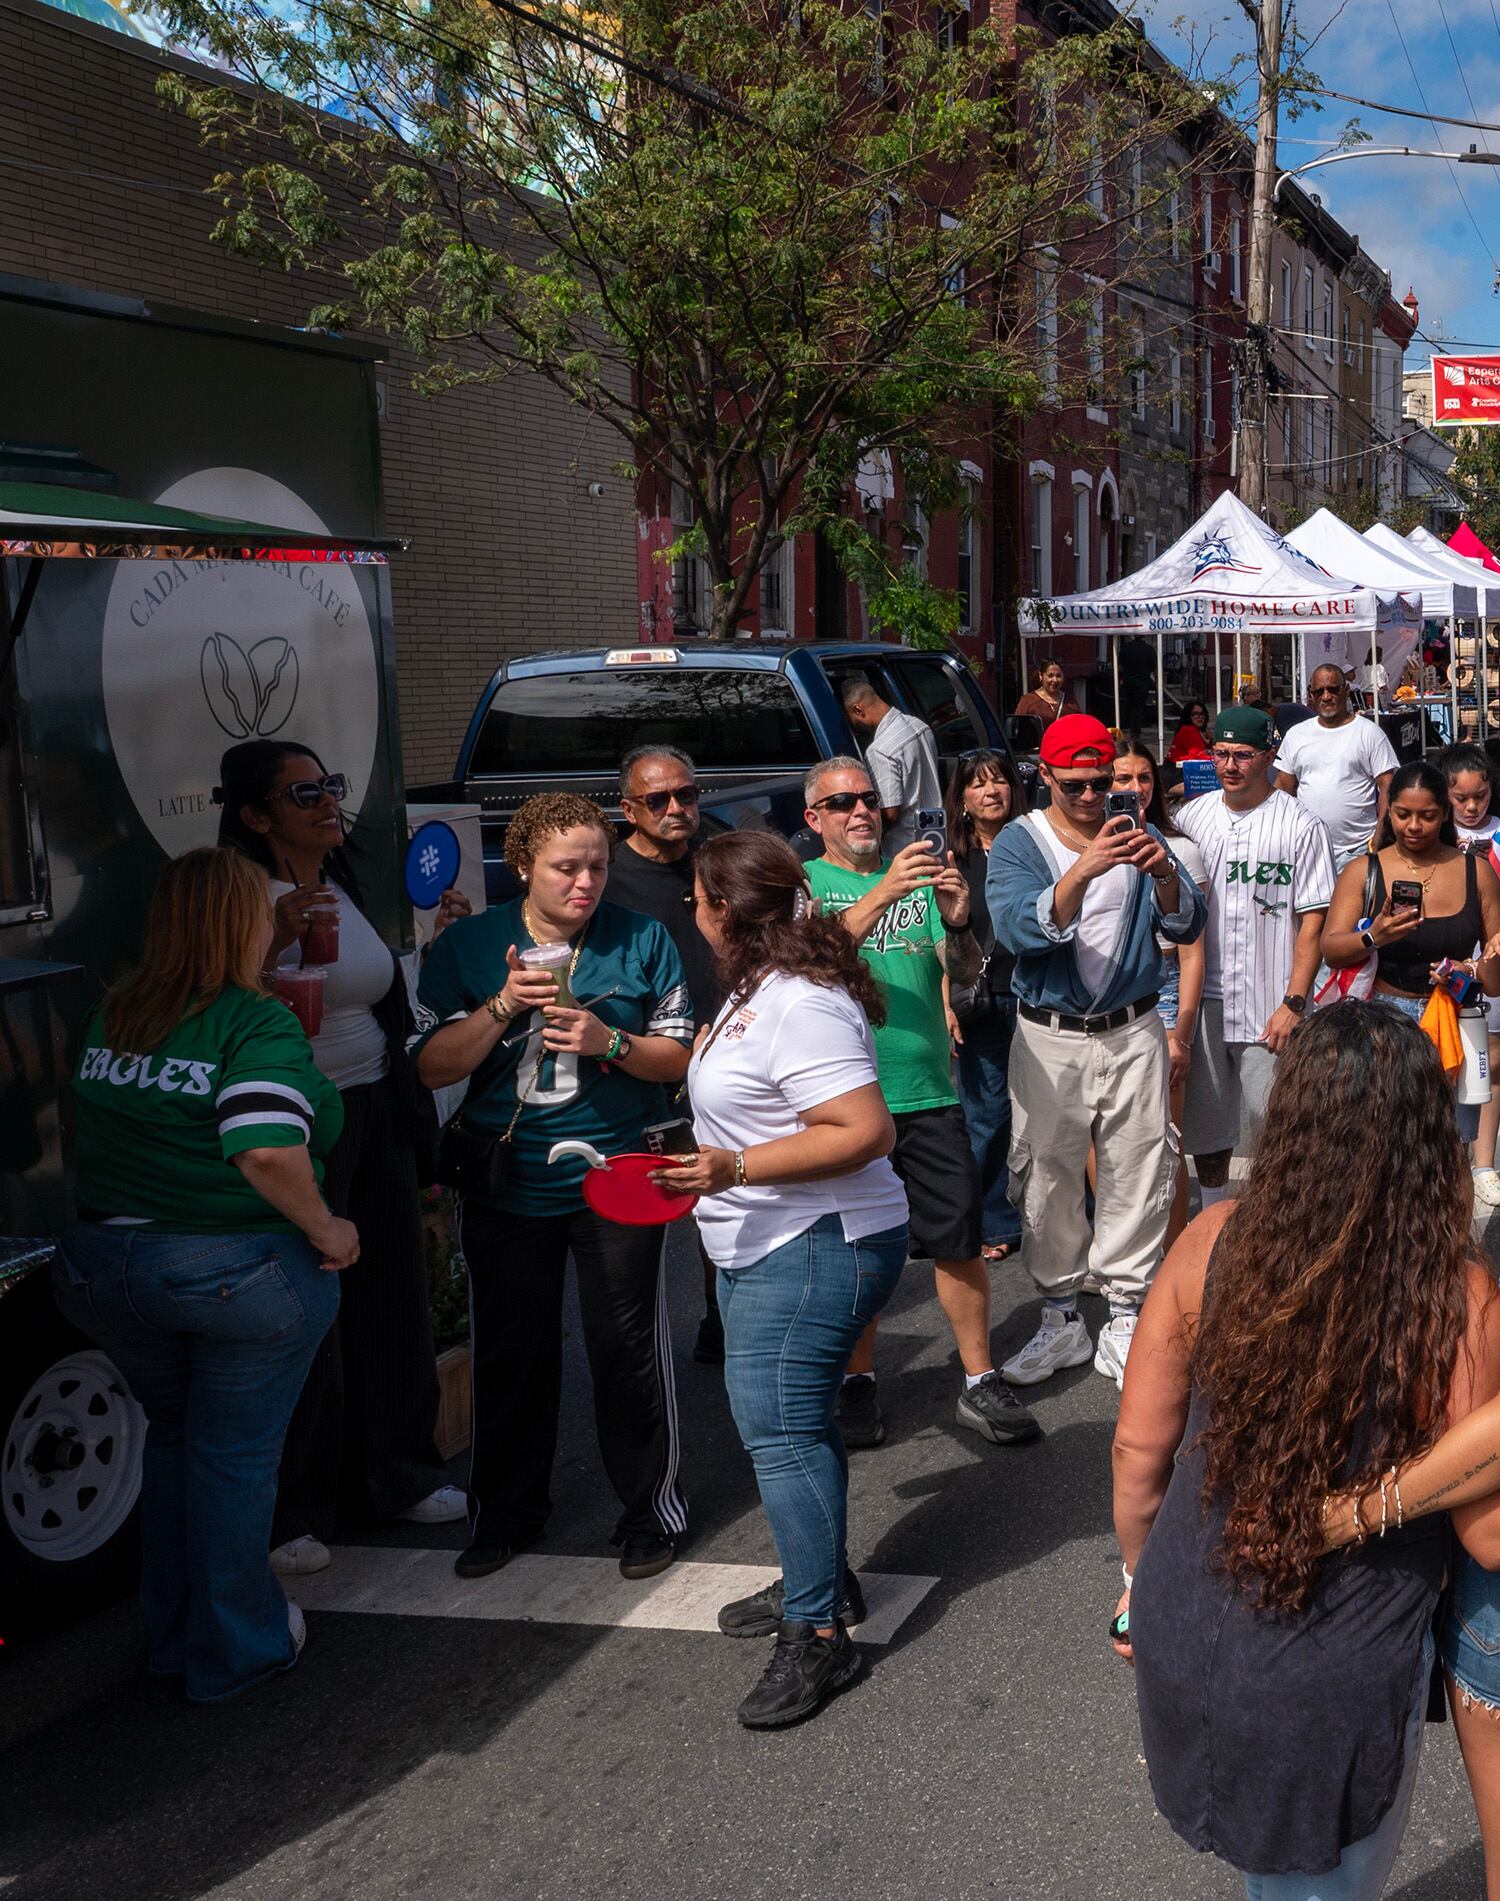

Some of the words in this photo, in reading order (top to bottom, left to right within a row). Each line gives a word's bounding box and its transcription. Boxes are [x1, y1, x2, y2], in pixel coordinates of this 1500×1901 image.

[1469, 377, 1490, 386] Arts
[129, 560, 189, 628] CADA
[299, 564, 350, 628] CAFÉ
[1056, 599, 1204, 621] OUNTRYWIDE
[1211, 600, 1284, 616] HOME
[1292, 599, 1356, 616] CARE
[1149, 616, 1244, 631] 800-203-9084
[157, 793, 206, 818] LATTE
[80, 1047, 217, 1096] EAGLES
[1478, 1050, 1487, 1079] WEBFX
